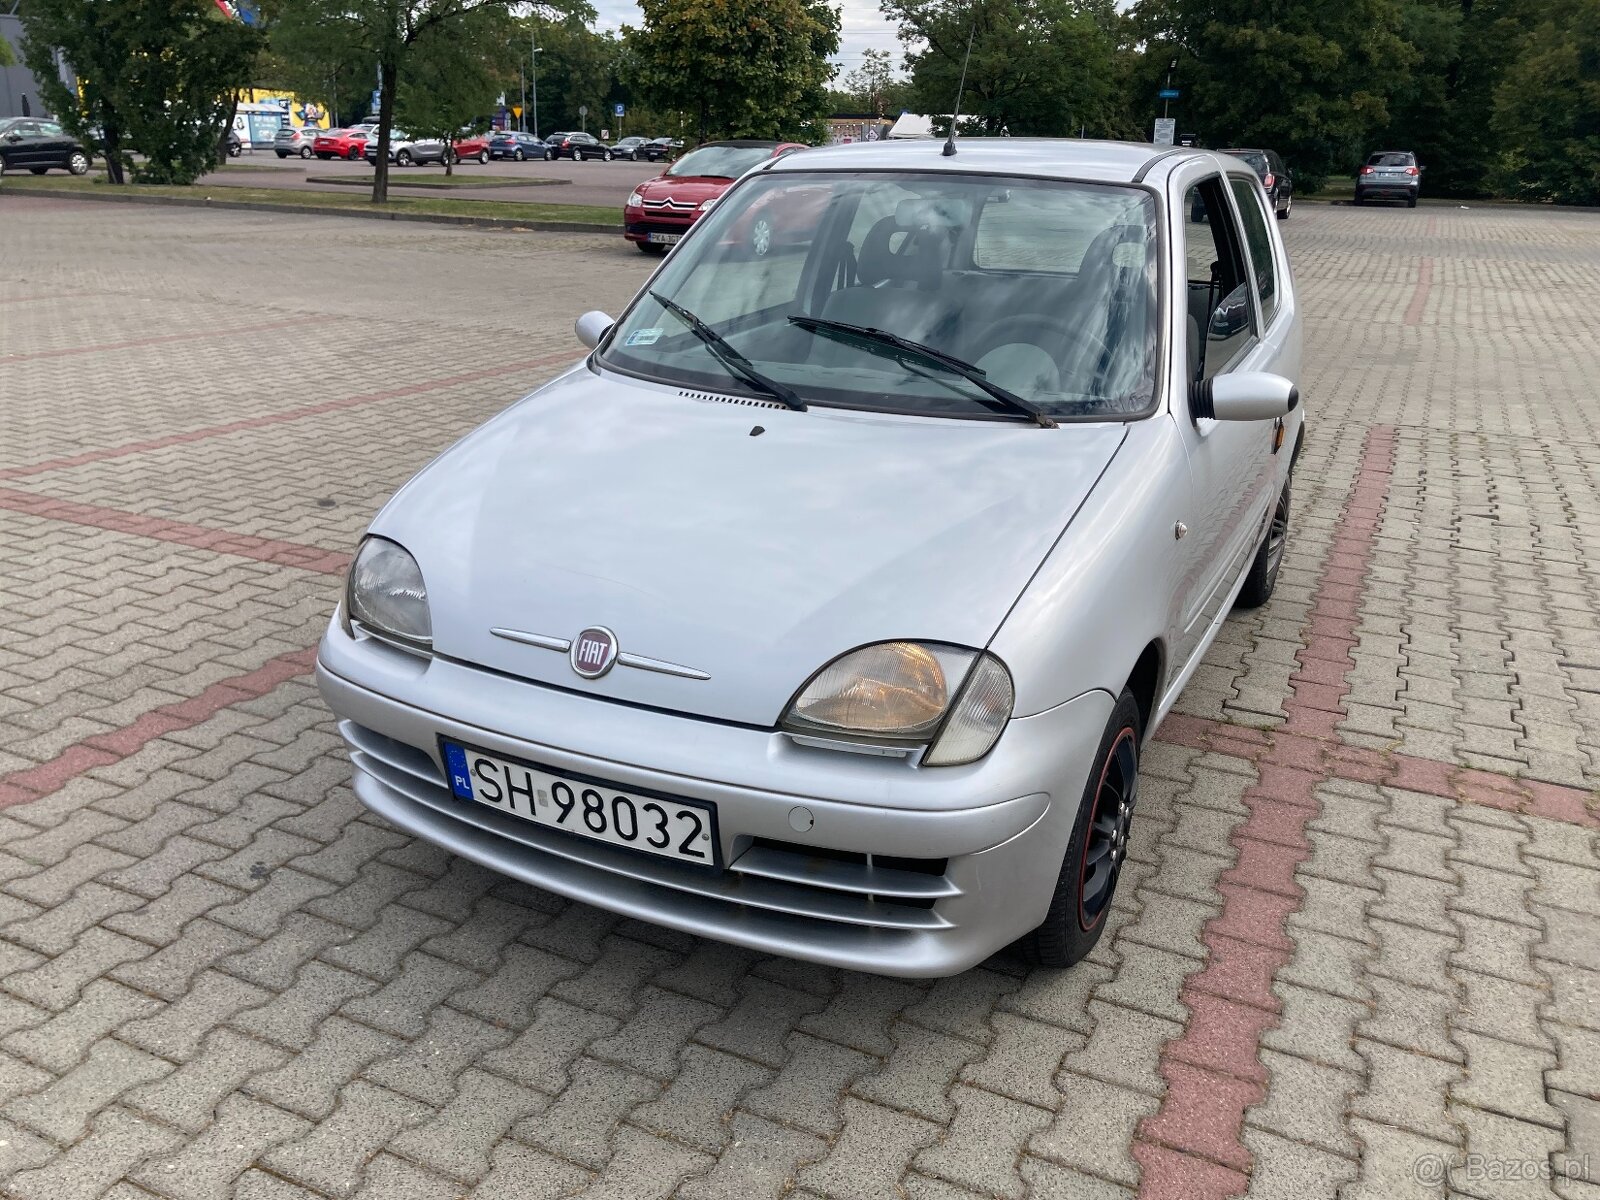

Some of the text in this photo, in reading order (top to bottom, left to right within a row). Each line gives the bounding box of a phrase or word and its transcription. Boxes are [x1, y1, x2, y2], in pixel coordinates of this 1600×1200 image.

[579, 639, 608, 665] FIAT
[454, 775, 470, 790] PL
[474, 758, 705, 858] SH 98032
